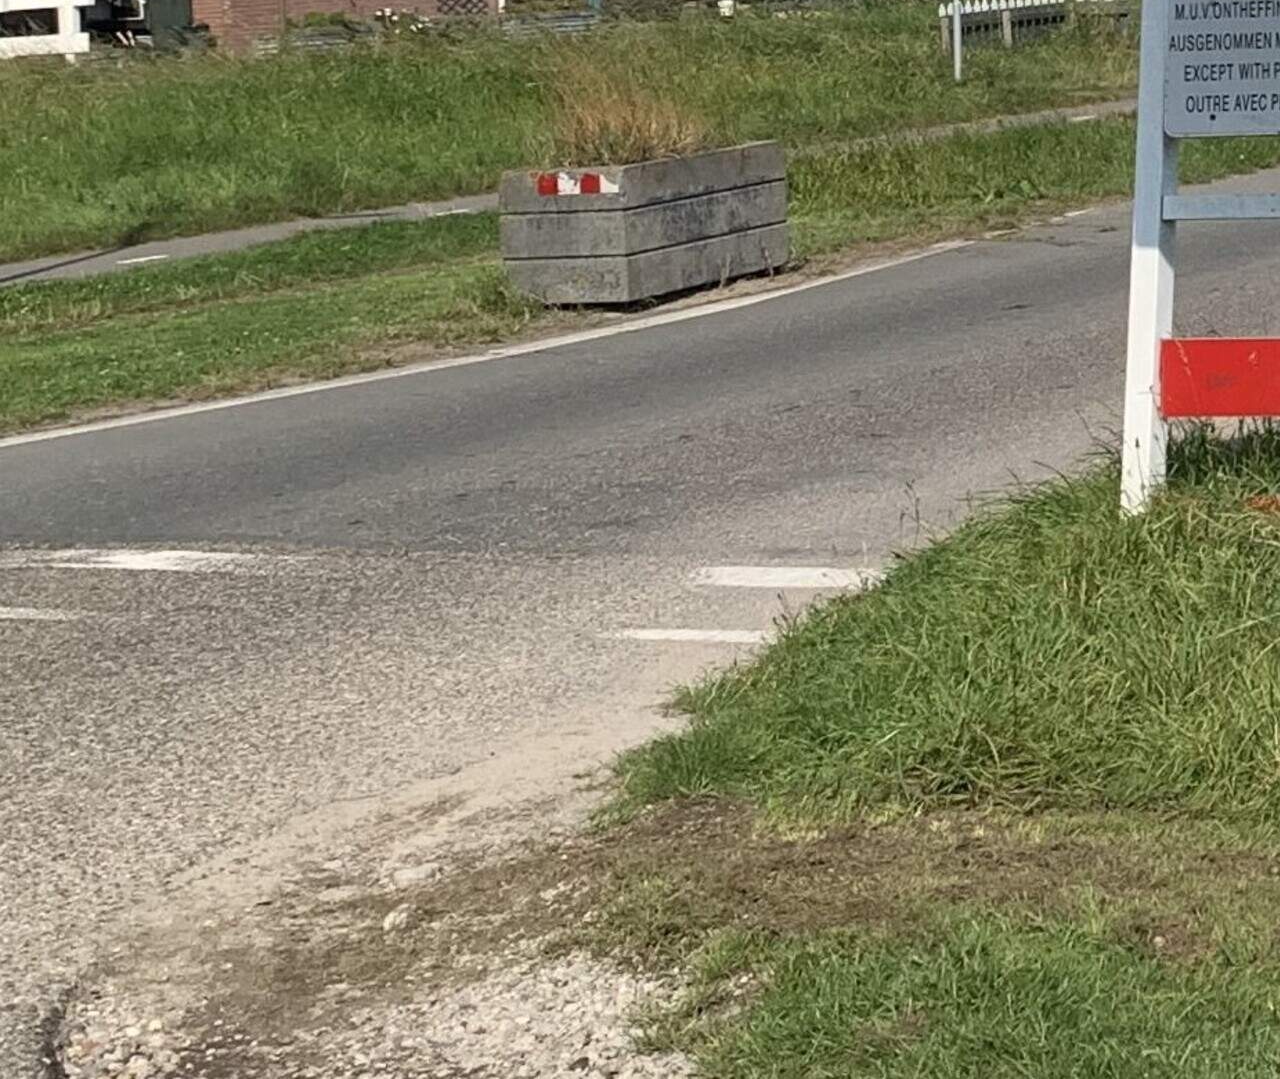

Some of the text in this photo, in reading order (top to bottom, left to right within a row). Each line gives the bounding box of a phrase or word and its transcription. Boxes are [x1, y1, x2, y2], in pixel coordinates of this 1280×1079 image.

[1169, 32, 1272, 51] AUSGENOMMEN
[1184, 63, 1234, 82] EXCEPT
[1238, 62, 1270, 80] WITH
[1185, 94, 1230, 113] OUTRE
[1233, 93, 1268, 112] AVEC
